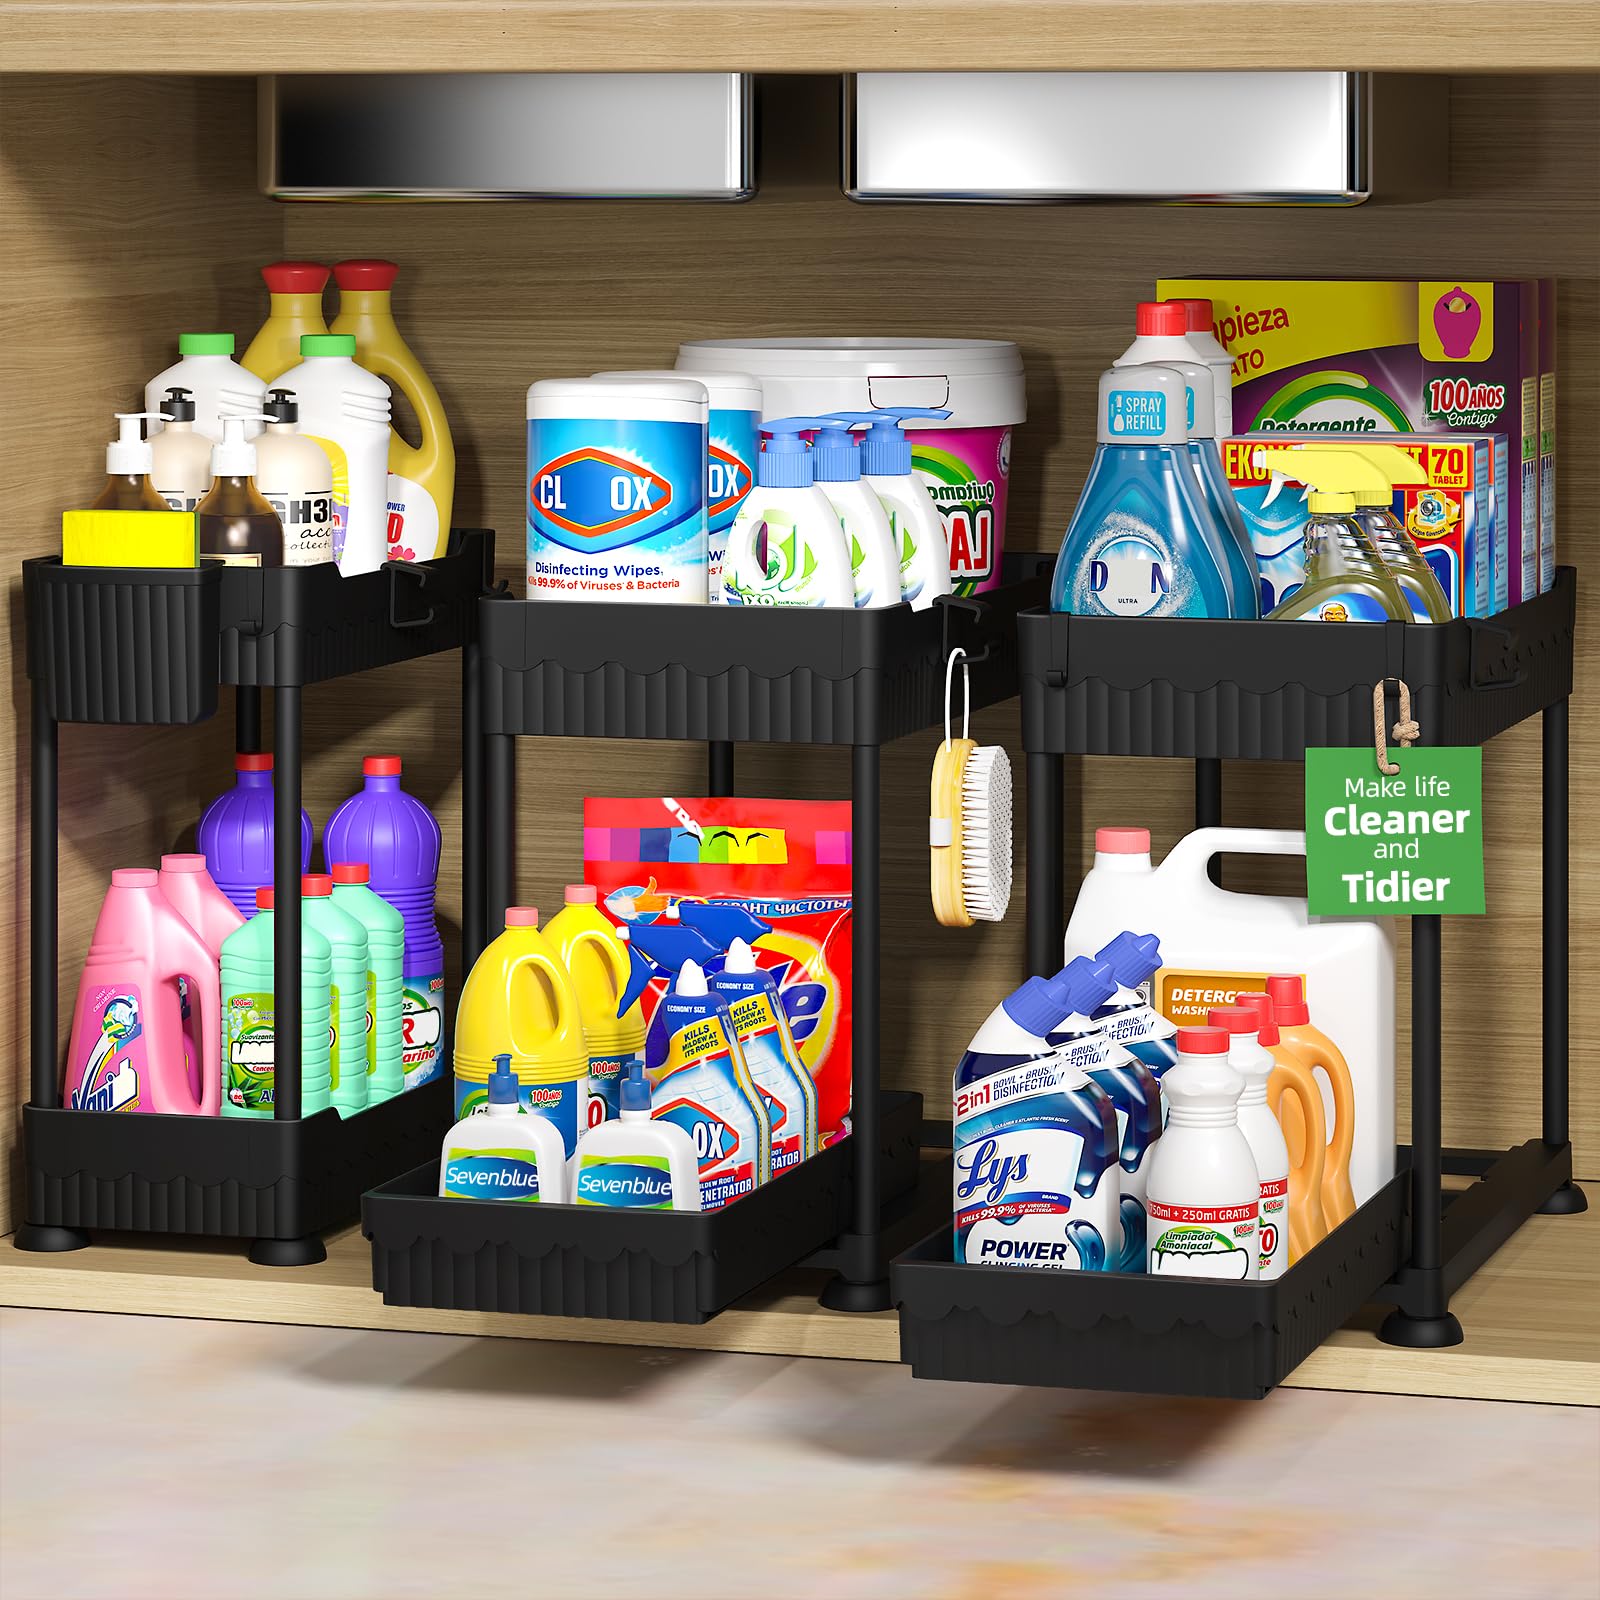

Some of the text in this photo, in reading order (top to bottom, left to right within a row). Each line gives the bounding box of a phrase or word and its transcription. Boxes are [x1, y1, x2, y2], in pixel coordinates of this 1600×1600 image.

[1213, 305, 1289, 351] pieza
[1126, 398, 1162, 412] SPRAY
[1126, 414, 1162, 430] REFILL
[1448, 412, 1498, 428] Contigo
[1432, 449, 1464, 474] 70
[1434, 475, 1464, 485] TABLET
[540, 474, 652, 511] CL OX
[536, 562, 661, 578] Disinfecting Wipes
[538, 577, 566, 589] 99.9%
[567, 580, 578, 590] of
[580, 580, 622, 590] Viruses
[626, 581, 634, 590] &
[638, 579, 680, 590] Bacteria
[1346, 776, 1450, 798] Make life
[1324, 804, 1470, 836] Cleaner
[1374, 838, 1419, 859] and
[1342, 871, 1450, 903] Tidier
[716, 982, 741, 990] ECONOMY
[667, 1005, 692, 1013] ECONOMY
[733, 1001, 758, 1018] KILLS
[757, 1008, 764, 1016] AT
[744, 1016, 766, 1028] ROOTS
[682, 1032, 717, 1051] MILDEW AT
[684, 1025, 710, 1042] KILLS
[685, 1040, 719, 1058] ITS ROOTS
[592, 1062, 607, 1074] 100
[994, 1075, 1016, 1089] BOWL
[994, 1072, 1064, 1100] DISINFECTION
[531, 1090, 548, 1102] 100
[958, 1084, 990, 1116] 2in1
[446, 1167, 539, 1187] Sevenblue
[719, 1176, 734, 1184] ROOT
[956, 1140, 1030, 1203] Lys
[578, 1175, 672, 1196] Sevenblue
[962, 1206, 1015, 1224] KILLS 99.9%
[1182, 1209, 1216, 1220] 250ml
[1219, 1208, 1250, 1220] GRATIS
[1160, 1241, 1212, 1250] Amoniacal
[1165, 1232, 1216, 1242] Limpiador
[981, 1239, 1067, 1260] POWER
